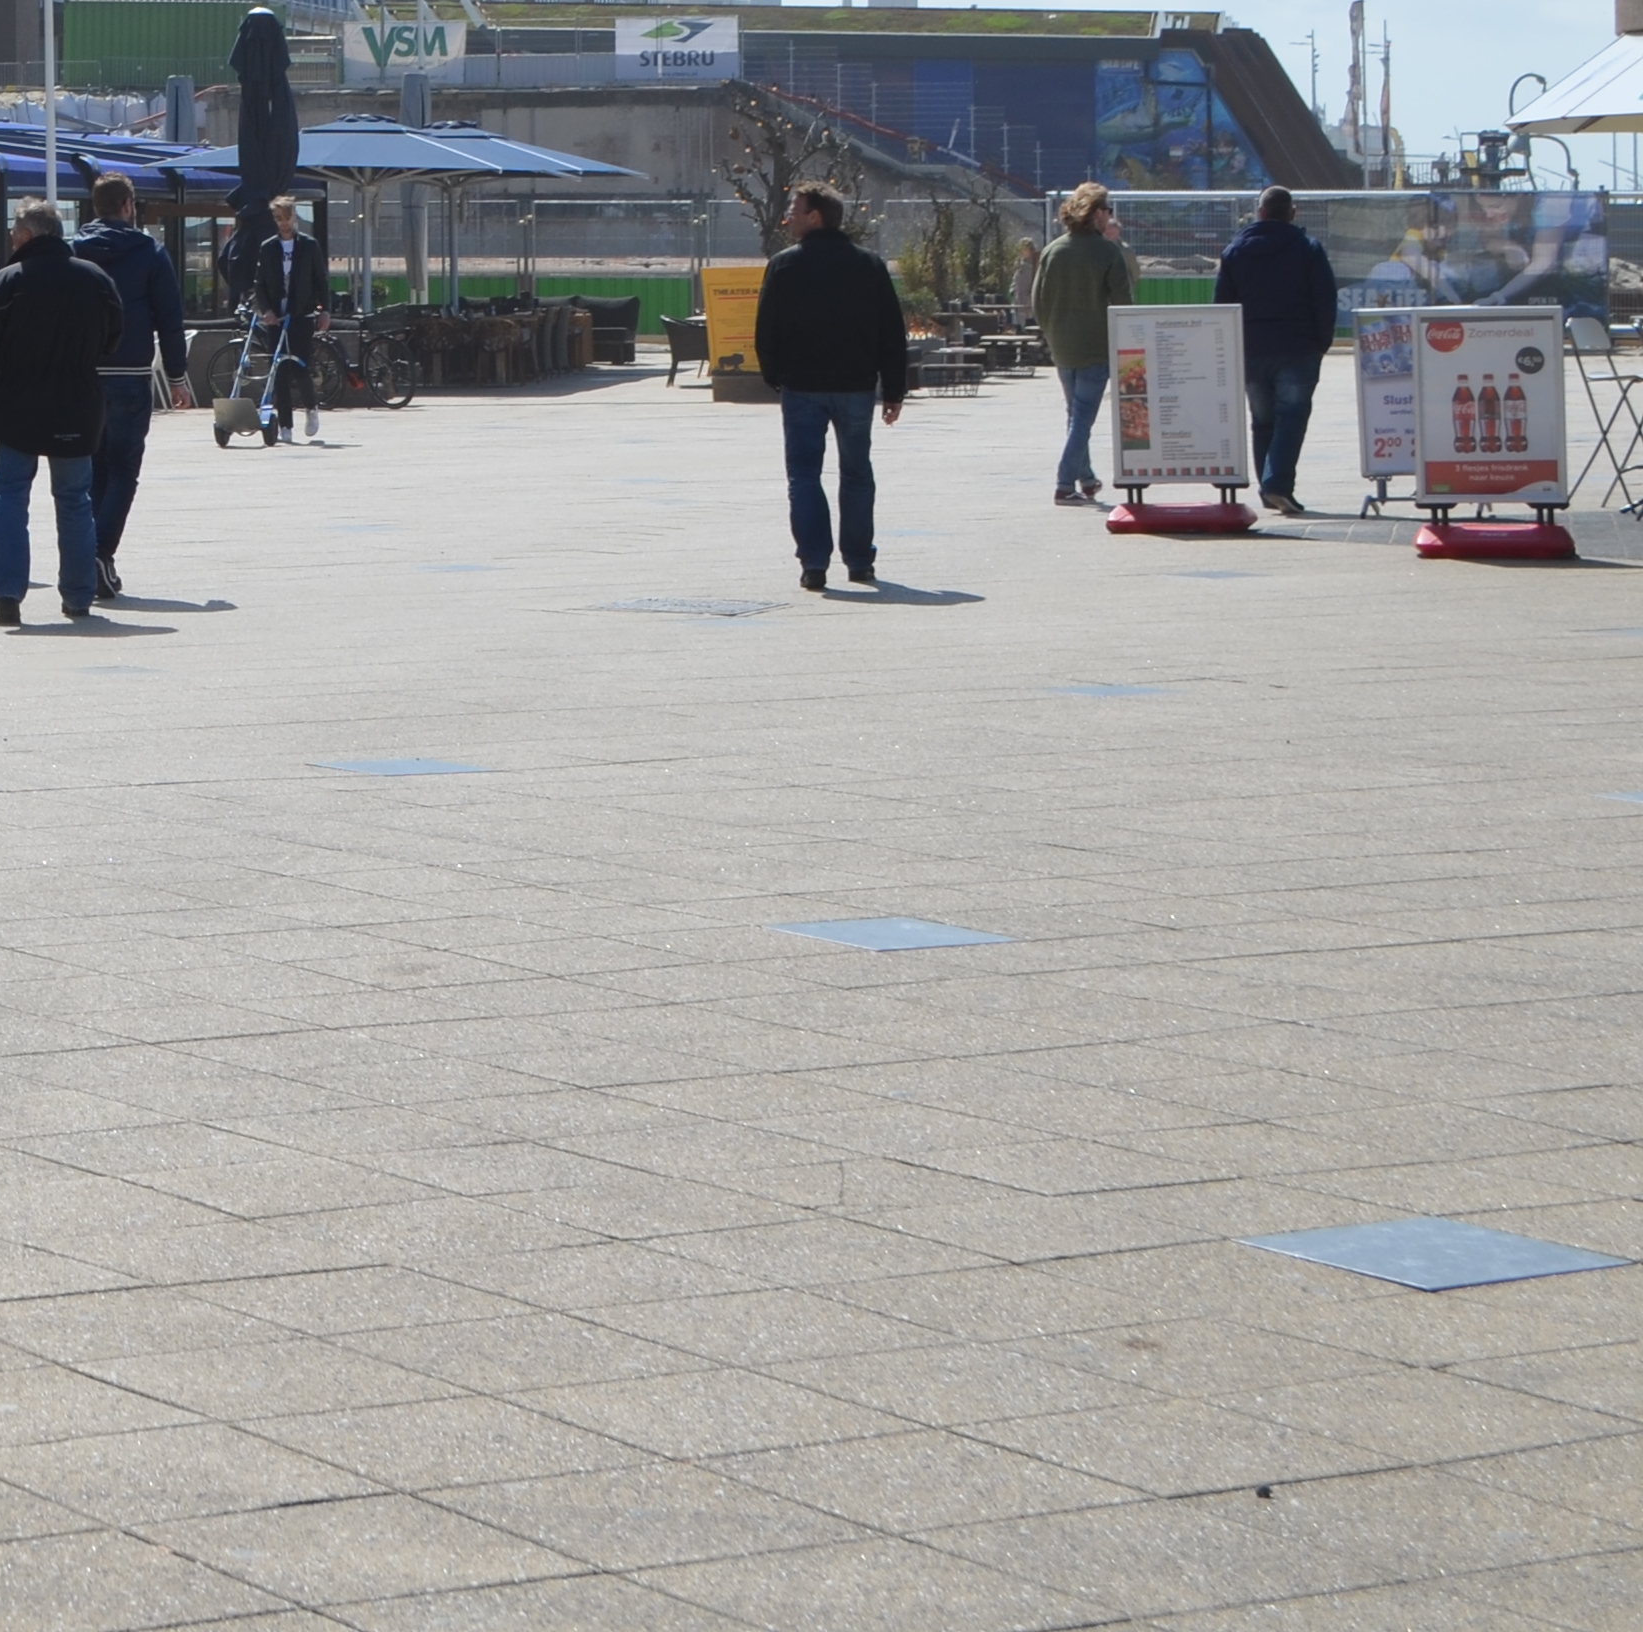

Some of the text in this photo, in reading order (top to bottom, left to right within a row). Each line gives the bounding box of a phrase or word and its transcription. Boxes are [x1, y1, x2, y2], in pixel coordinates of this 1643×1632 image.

[362, 26, 448, 67] VSM
[639, 51, 715, 68] STEBRU
[1337, 287, 1375, 310] SEA
[1467, 327, 1535, 337] Zomerdeal
